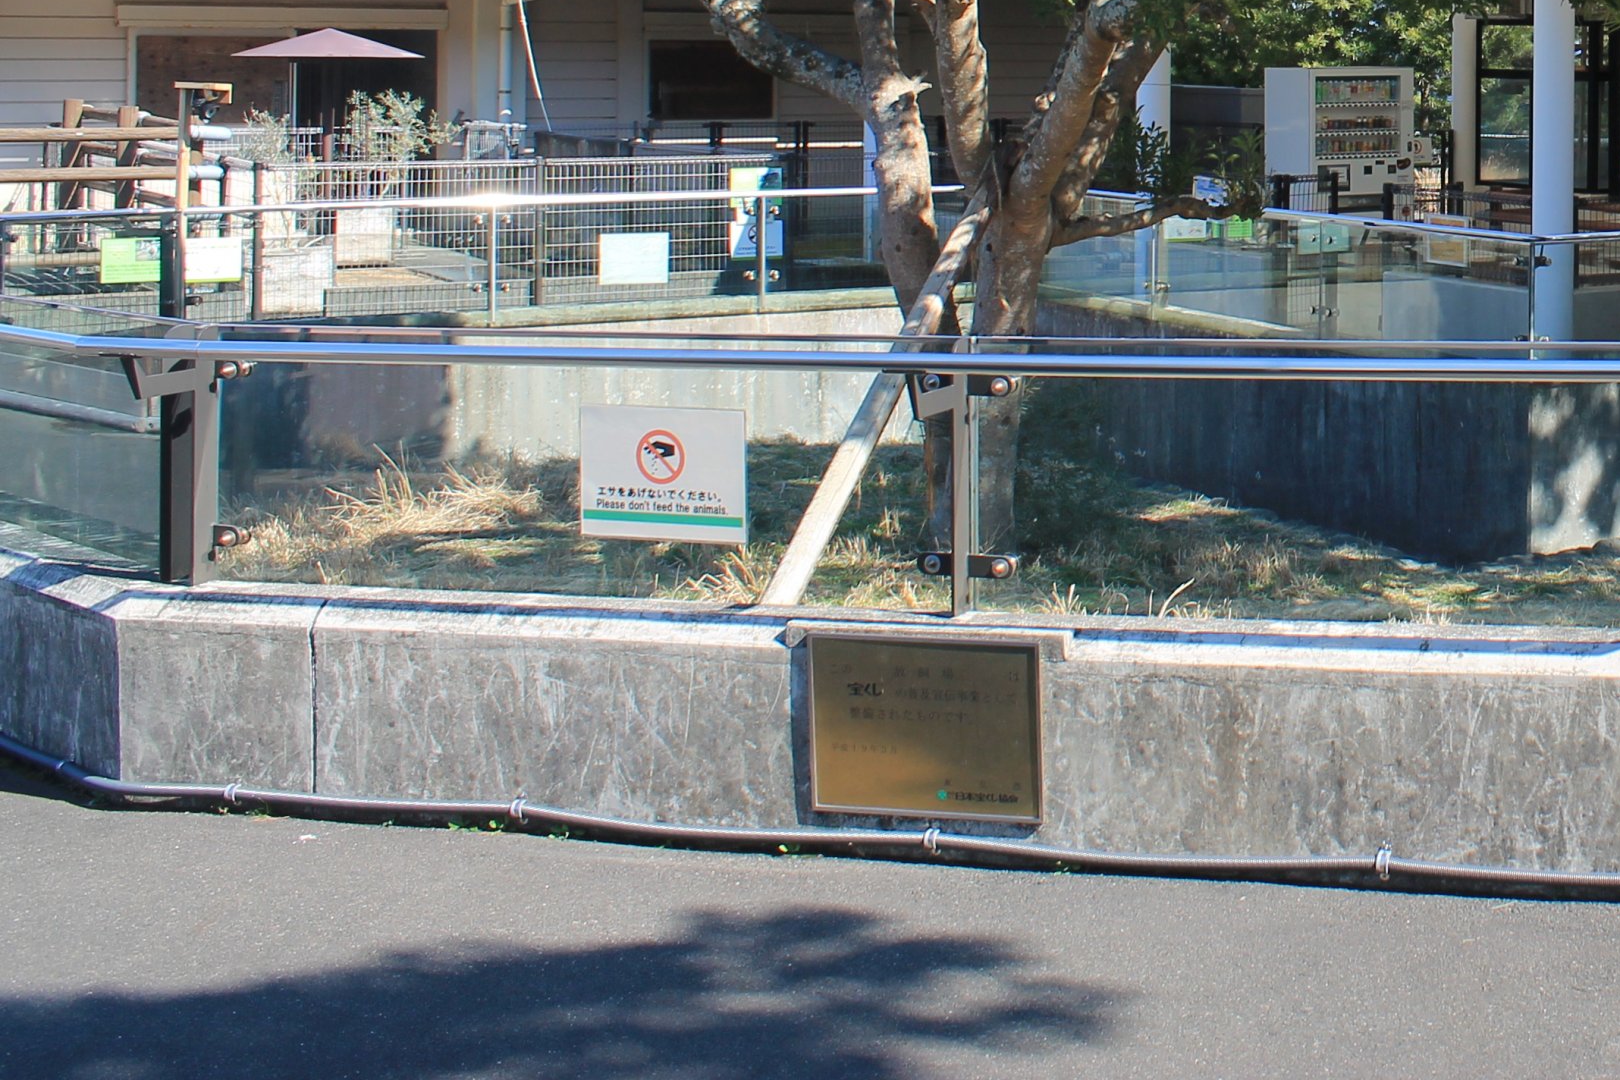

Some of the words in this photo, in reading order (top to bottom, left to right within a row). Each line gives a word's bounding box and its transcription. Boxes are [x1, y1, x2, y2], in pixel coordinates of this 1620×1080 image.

[597, 486, 722, 503] エサをあげないでください。
[596, 498, 625, 510] Please
[629, 500, 650, 511] don't
[653, 501, 673, 512] feed
[676, 503, 690, 513] the
[693, 505, 728, 516] animals.
